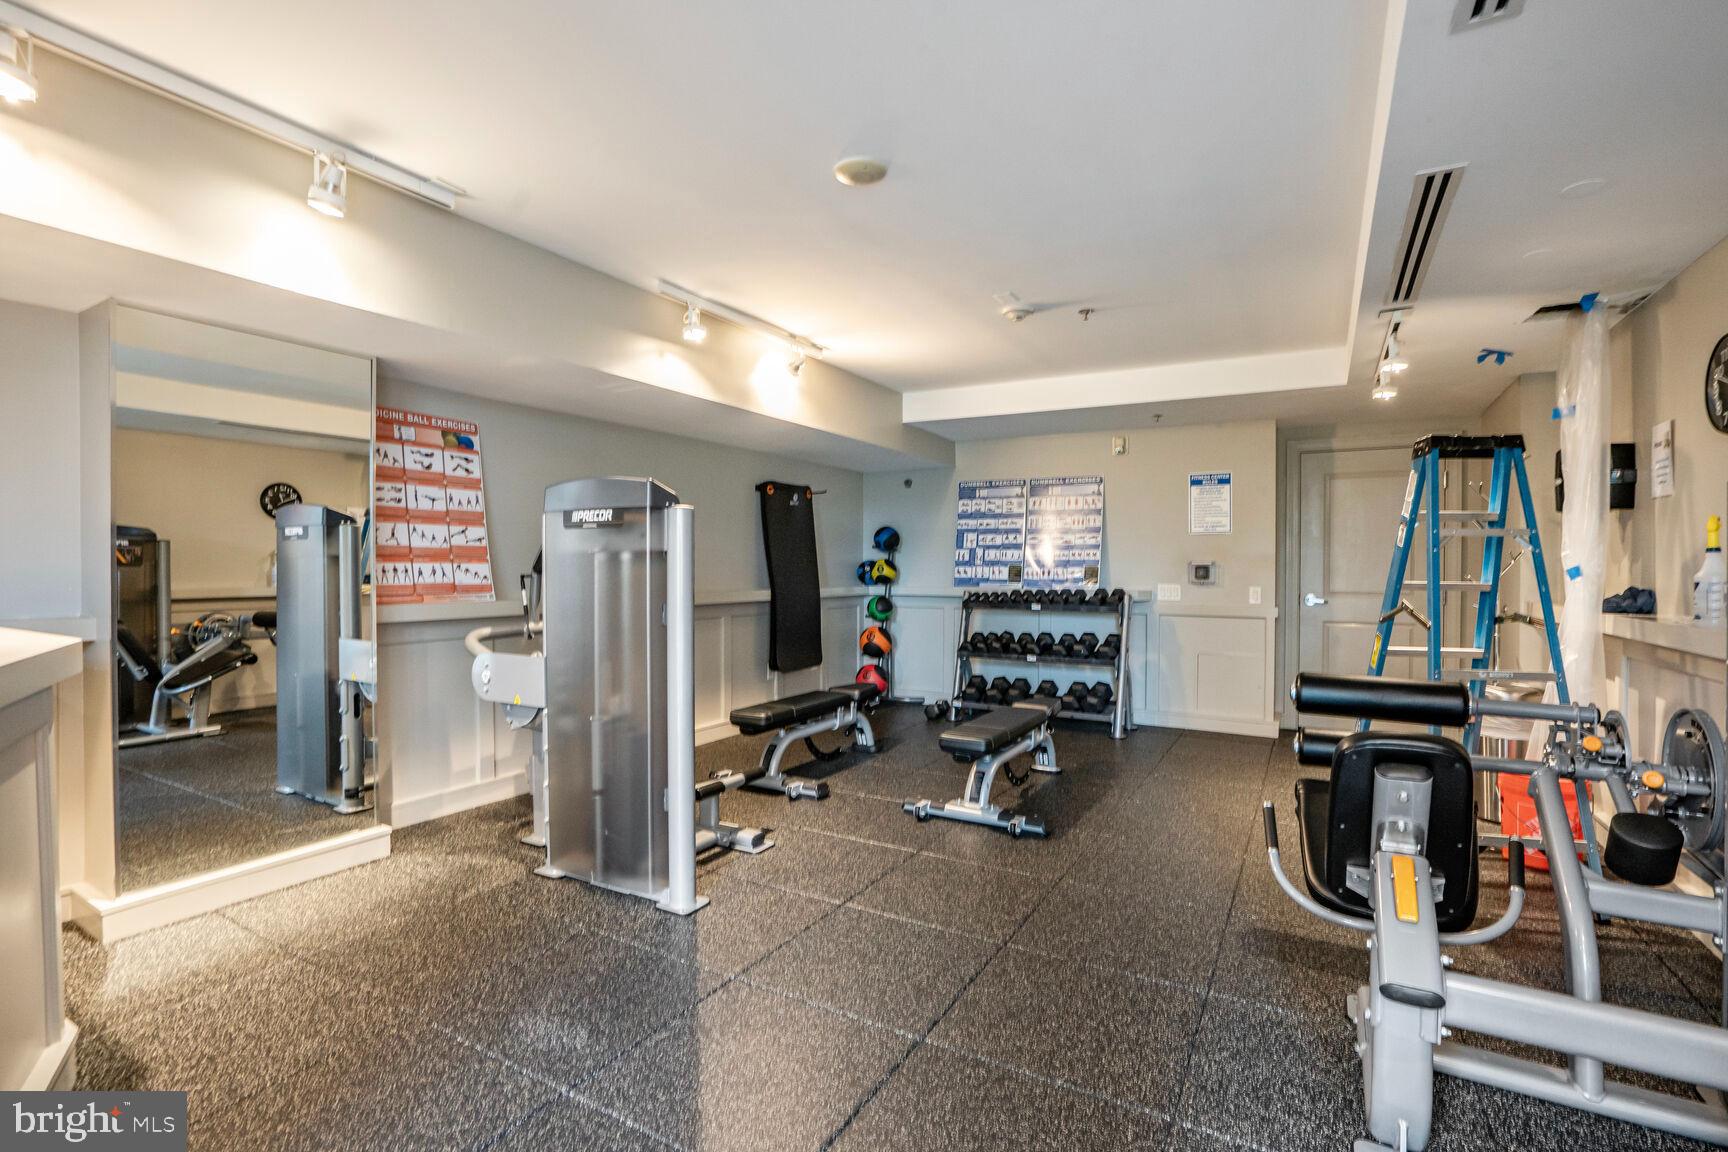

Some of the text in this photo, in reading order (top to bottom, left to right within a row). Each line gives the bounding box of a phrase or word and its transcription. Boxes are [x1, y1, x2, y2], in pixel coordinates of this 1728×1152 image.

[408, 414, 429, 425] BALL
[432, 418, 476, 432] EXERCISES
[577, 508, 613, 522] PRECOR
